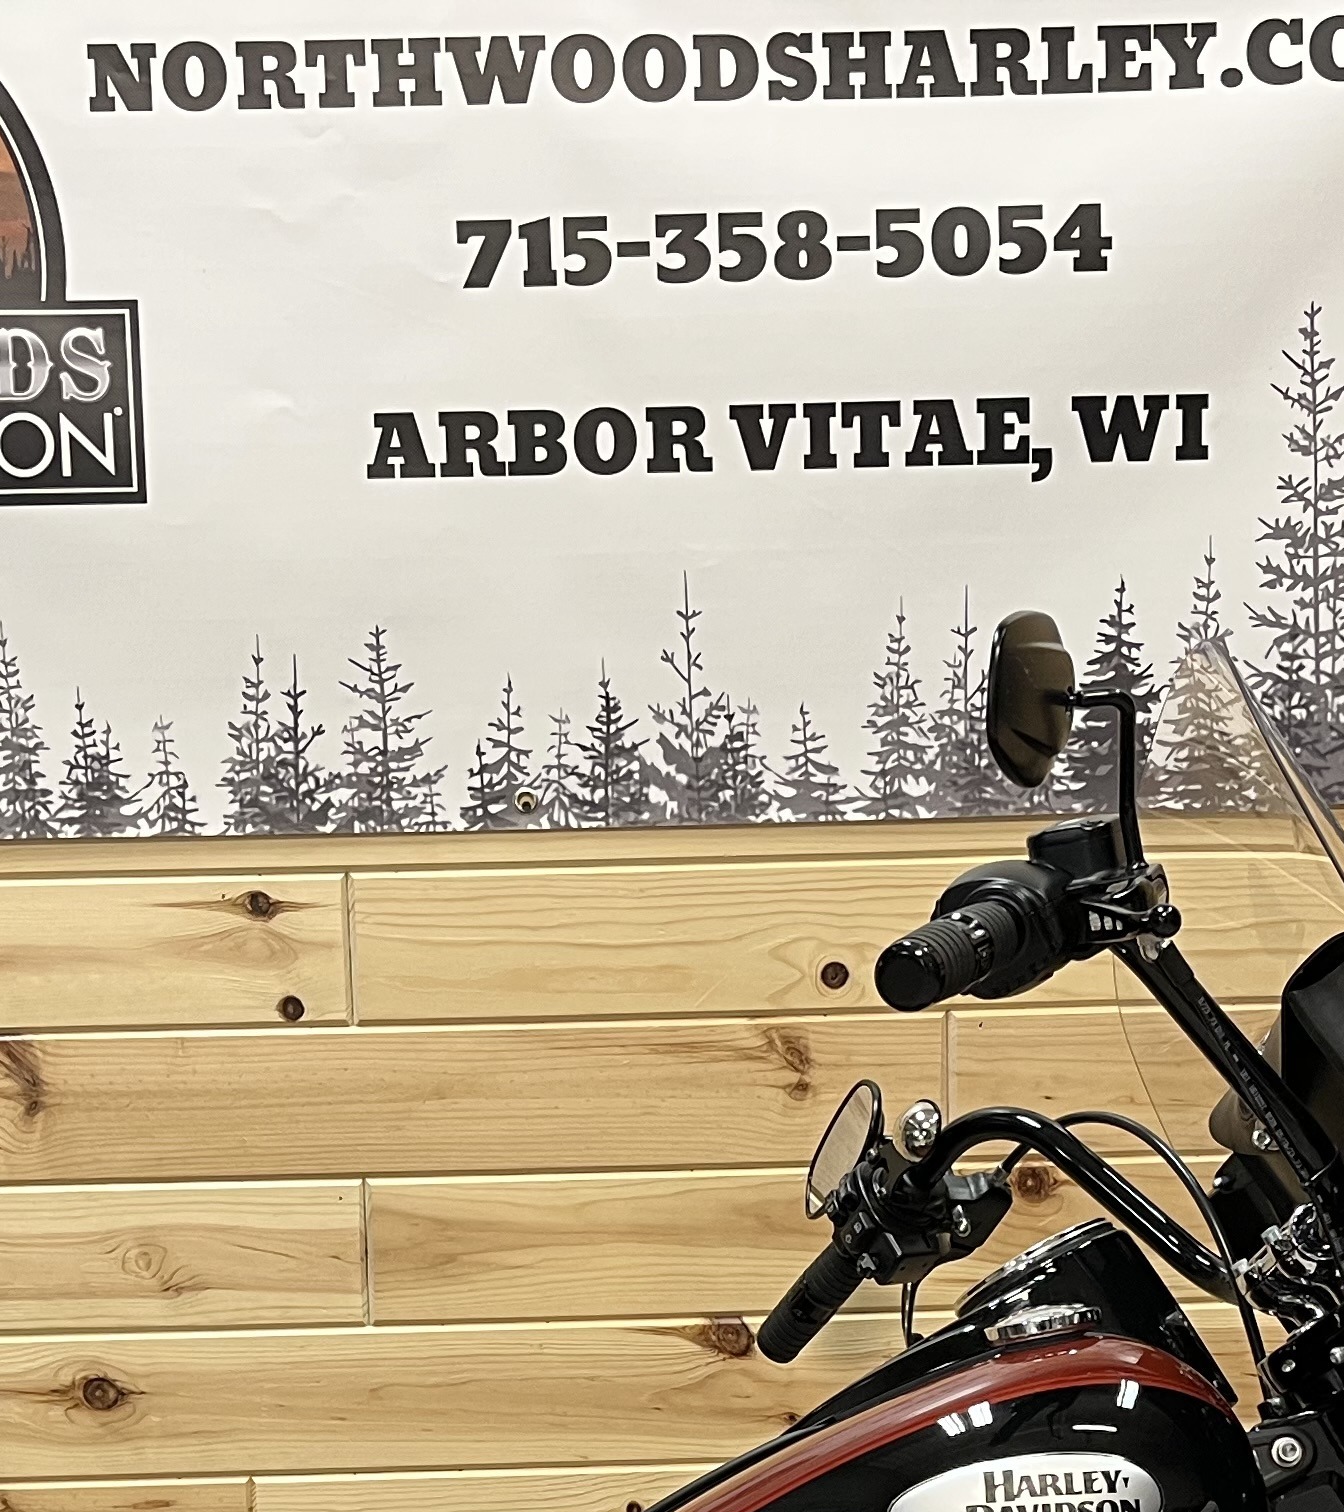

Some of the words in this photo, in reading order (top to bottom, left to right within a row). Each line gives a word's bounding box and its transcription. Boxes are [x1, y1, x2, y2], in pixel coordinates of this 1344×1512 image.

[455, 203, 1113, 289] 715-358-5054
[367, 406, 714, 481] ARBOR
[729, 394, 1054, 483] VITAE,
[1072, 393, 1209, 464] WI
